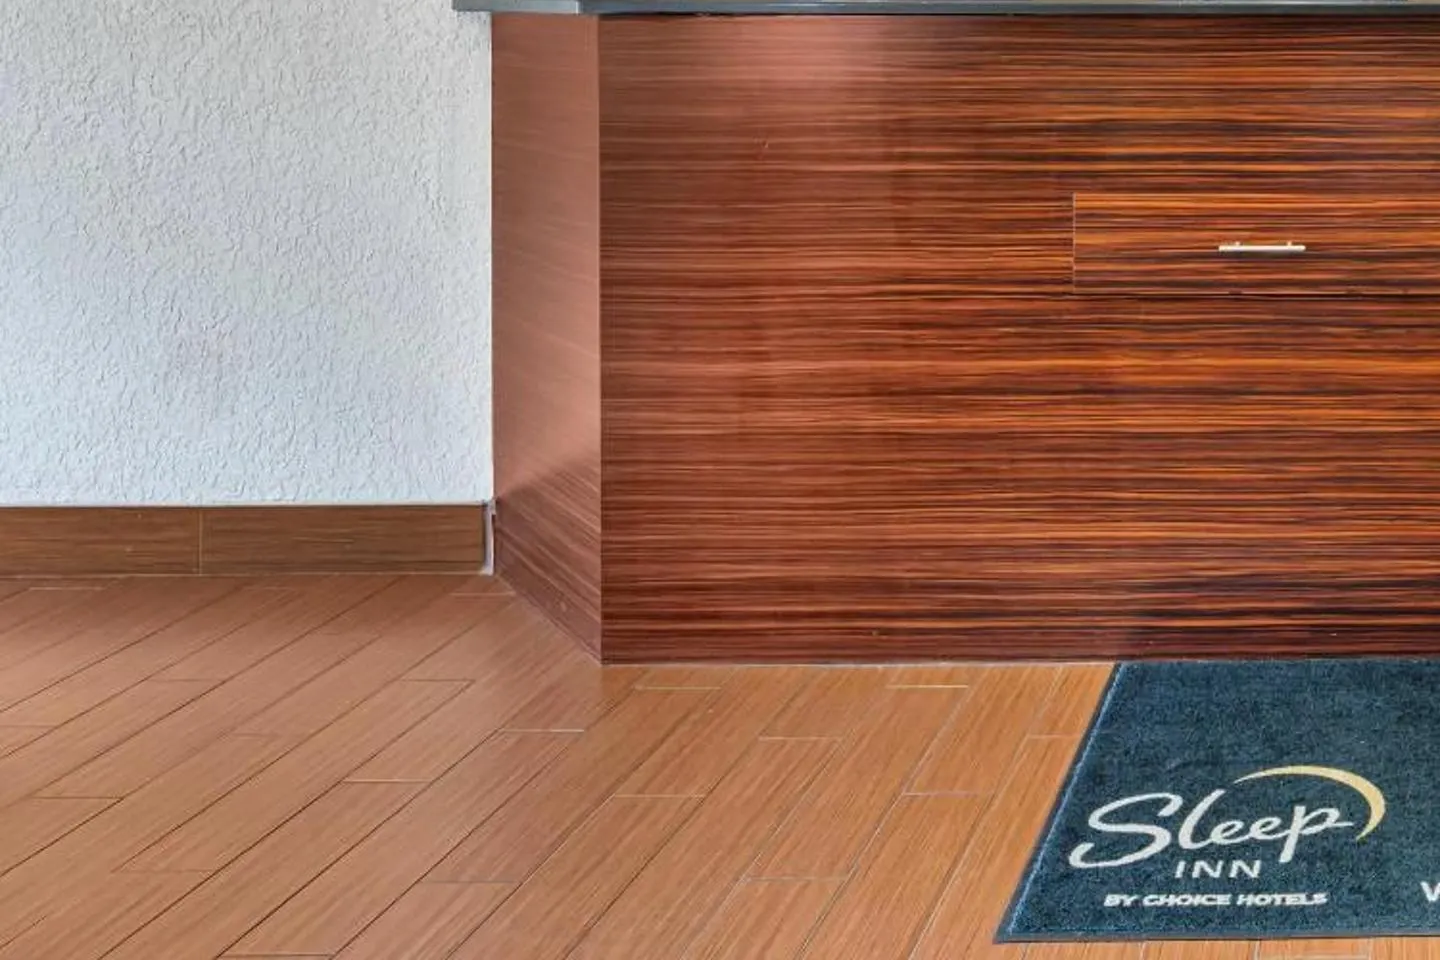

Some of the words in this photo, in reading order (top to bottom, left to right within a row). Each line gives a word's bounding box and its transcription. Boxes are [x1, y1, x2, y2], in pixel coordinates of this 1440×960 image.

[1068, 789, 1354, 868] Sleep
[1174, 859, 1262, 879] INN
[1103, 893, 1137, 908] BY
[1141, 893, 1231, 907] CHOICE
[1236, 891, 1329, 906] HOTELS
